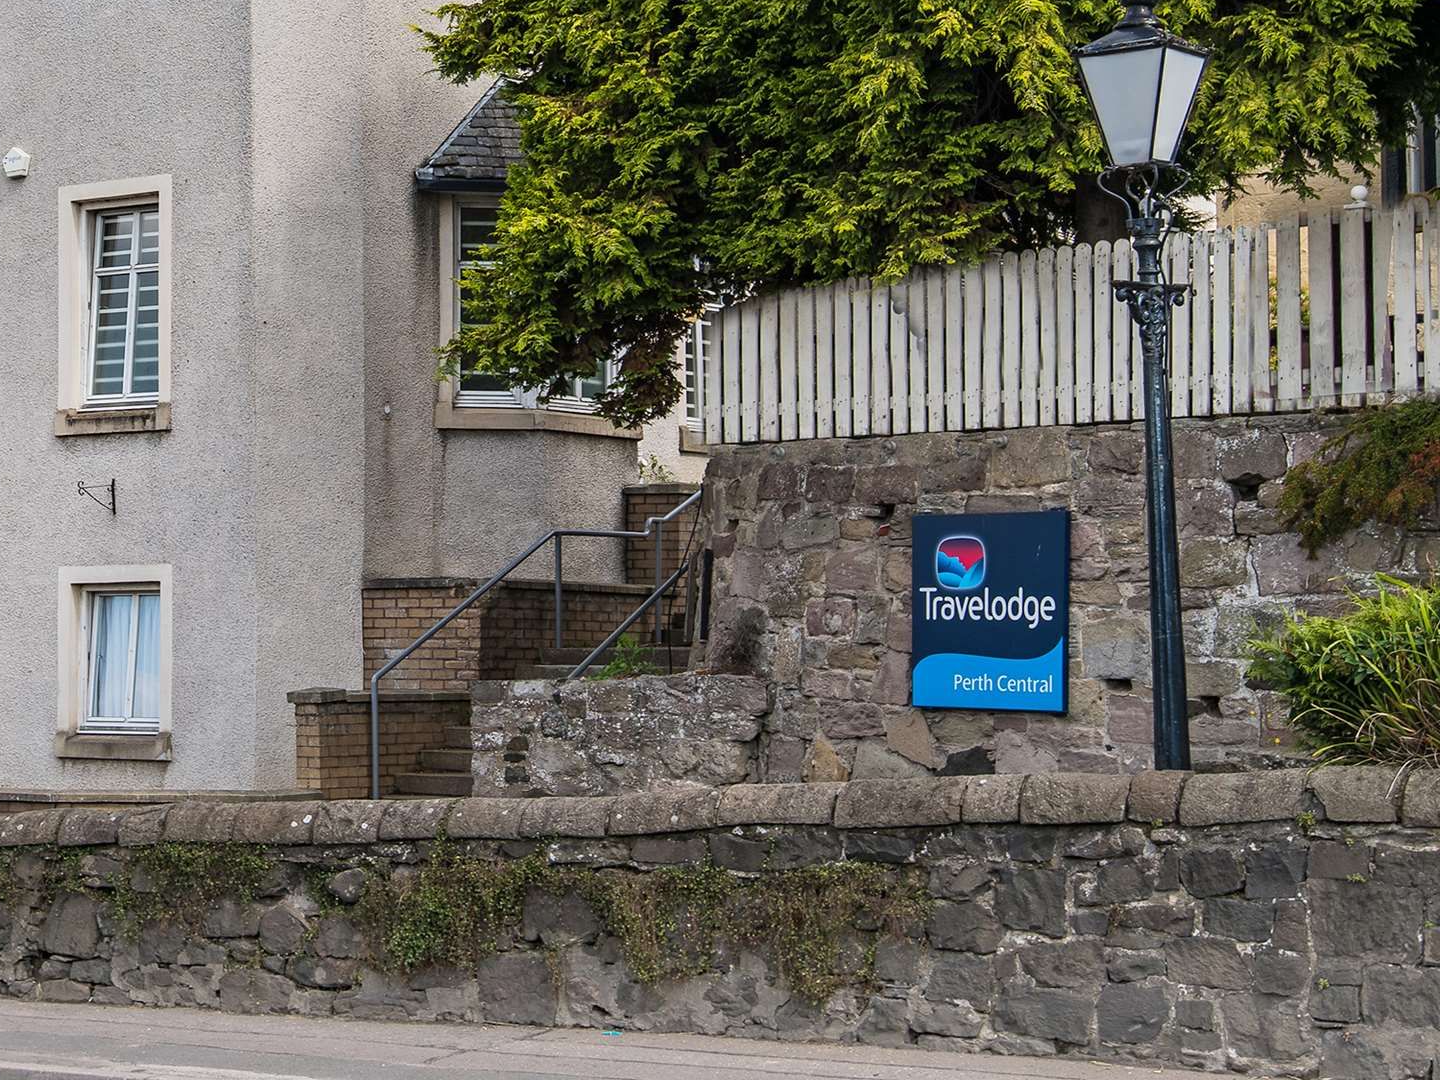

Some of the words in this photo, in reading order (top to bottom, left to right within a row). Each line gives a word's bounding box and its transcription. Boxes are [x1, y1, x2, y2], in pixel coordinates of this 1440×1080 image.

[919, 586, 1056, 629] Travelodge
[953, 673, 993, 691] Perth
[997, 674, 1053, 693] Central
